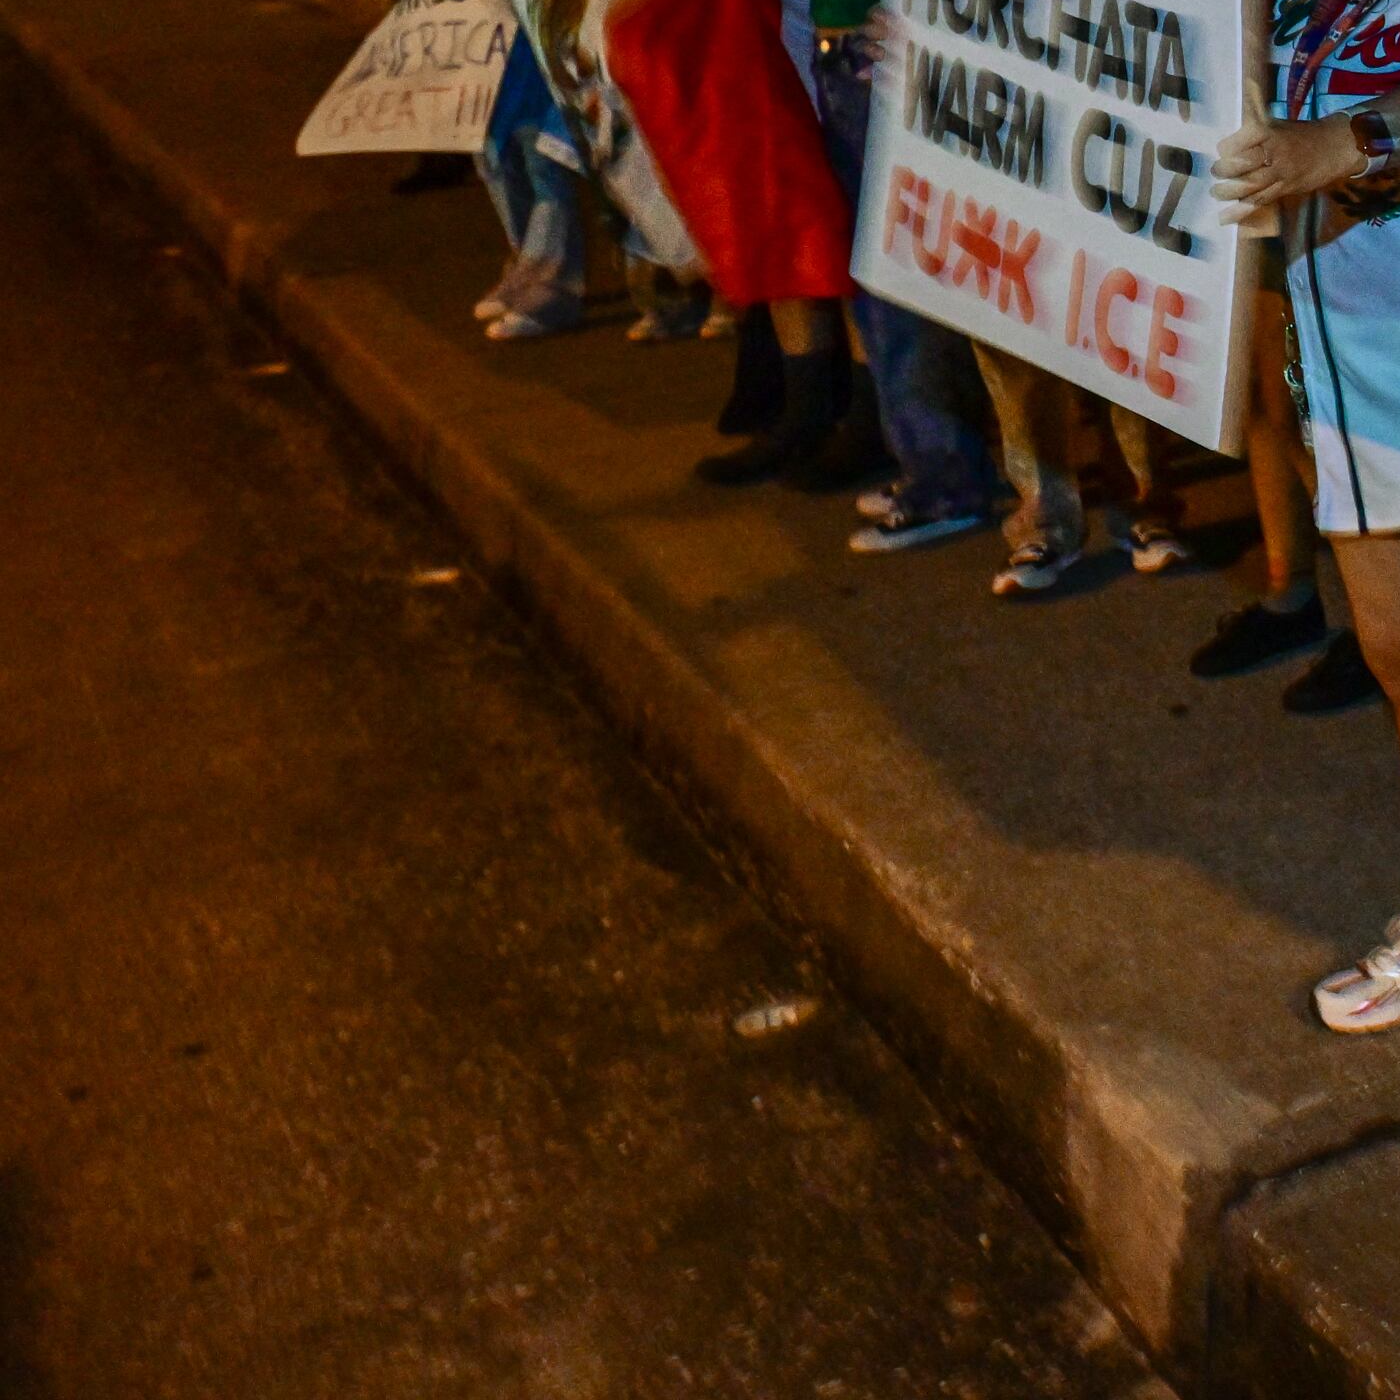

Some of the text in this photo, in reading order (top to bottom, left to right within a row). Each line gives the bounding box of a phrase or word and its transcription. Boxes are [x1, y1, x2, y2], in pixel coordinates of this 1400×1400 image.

[903, 39, 1194, 257] WARM CUZ
[1064, 247, 1185, 401] I.C.E
